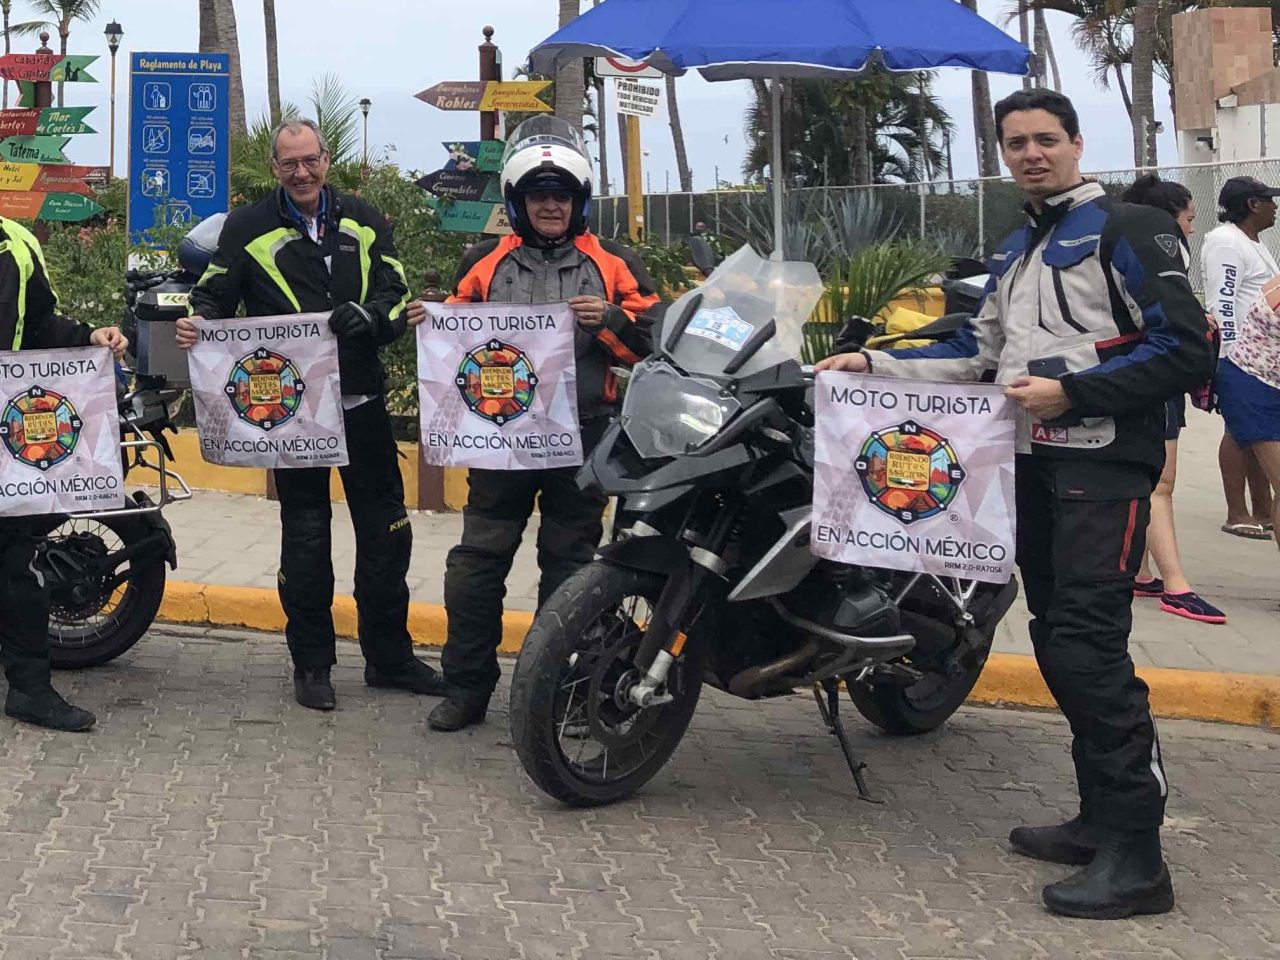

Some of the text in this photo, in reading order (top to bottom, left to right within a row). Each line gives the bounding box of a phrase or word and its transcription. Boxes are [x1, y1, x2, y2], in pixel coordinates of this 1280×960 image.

[140, 59, 222, 72] Reglamento de Playa
[617, 81, 660, 96] PROHIBIDO
[617, 92, 631, 100] TODO
[436, 95, 477, 109] Robles
[619, 101, 654, 113] MOTORIZADO
[49, 112, 71, 122] Mar
[36, 123, 45, 132] de
[8, 142, 40, 159] Tatema
[3, 164, 20, 172] Hotel
[12, 175, 22, 183] Sol
[1219, 264, 1237, 341] Isla del Coral
[432, 315, 556, 331] MOTO TURISTA
[201, 324, 320, 342] MOTO TURISTA
[30, 360, 97, 378] TURISTA
[831, 386, 991, 414] MOTO TURISTA
[904, 425, 916, 433] N
[204, 436, 338, 452] EN ACCIÓN MÉXICO
[429, 432, 573, 449] EN ACCIÓN MÉXICO
[952, 470, 961, 478] E
[61, 475, 117, 493] MÉXICO
[818, 526, 1006, 560] EN ACCIÓN MÉXICO
